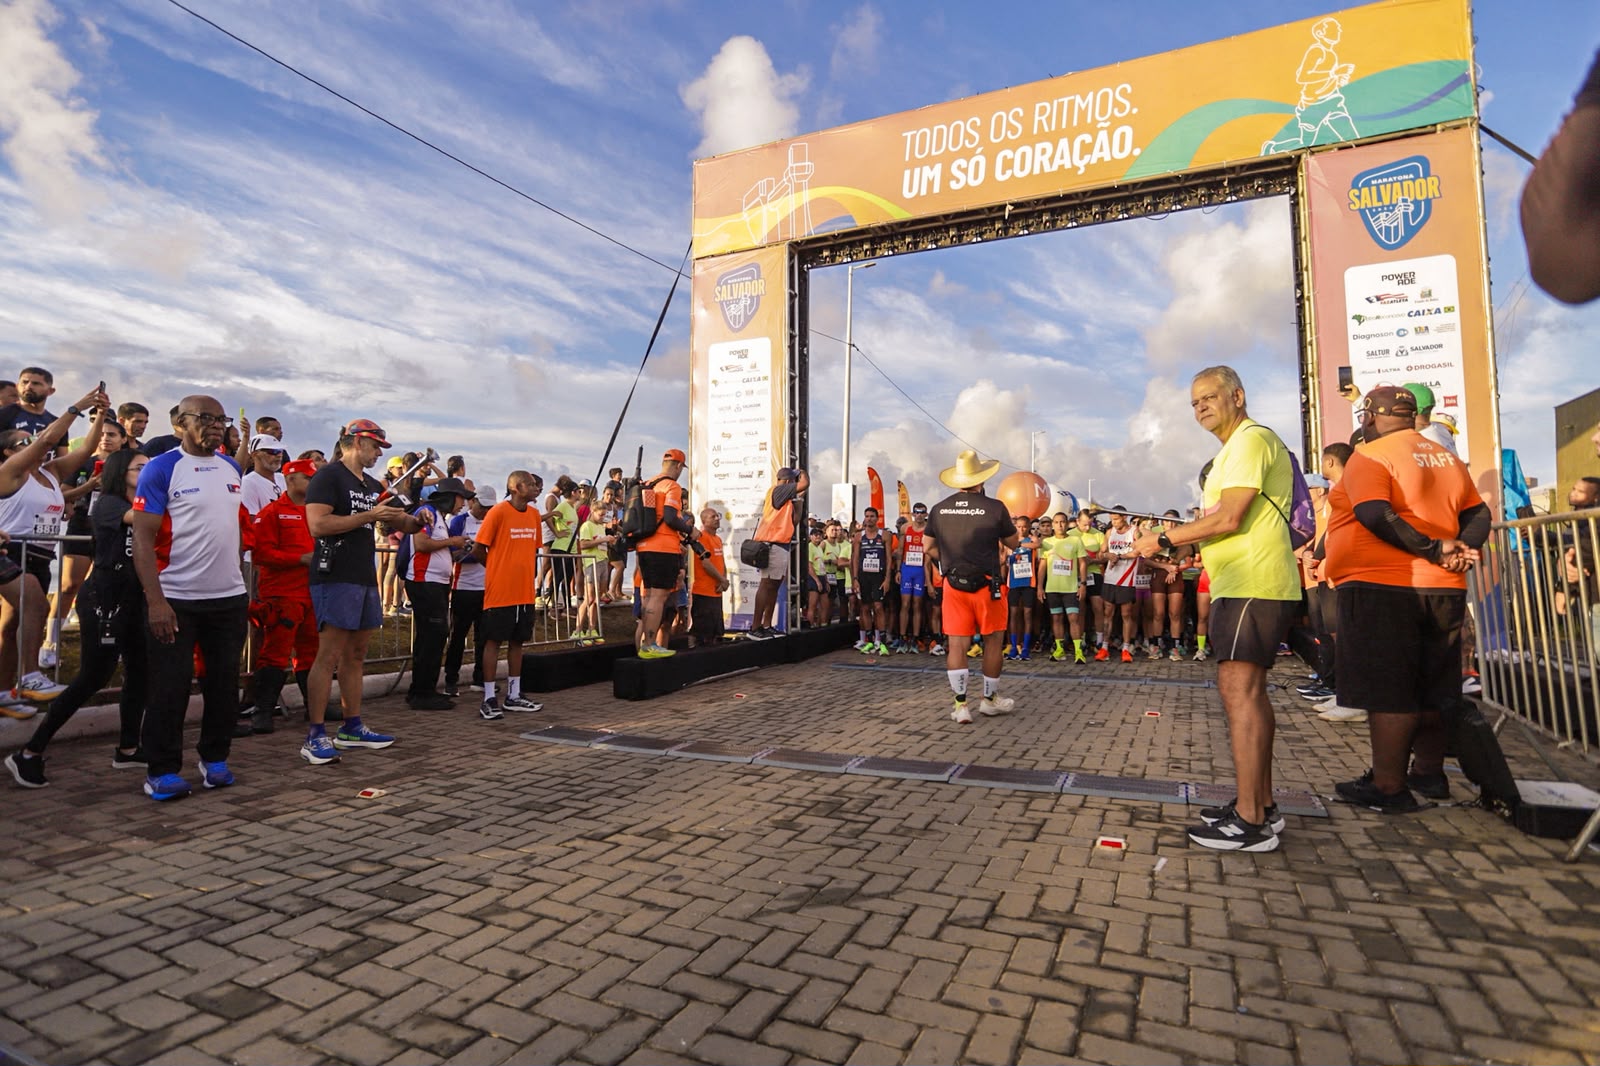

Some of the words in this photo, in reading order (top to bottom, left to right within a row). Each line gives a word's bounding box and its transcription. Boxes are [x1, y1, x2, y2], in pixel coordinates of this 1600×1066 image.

[902, 117, 980, 161] TODOS
[990, 107, 1023, 143] OS
[1033, 83, 1138, 135] RITMOS.
[902, 163, 942, 199] UM
[950, 147, 986, 190] SÓ
[995, 121, 1141, 182] CORAÇÃO.
[1371, 173, 1414, 185] MARATONA
[1349, 176, 1441, 211] SALVADOR
[1381, 271, 1416, 282] POWER
[1397, 278, 1416, 286] ADE
[714, 279, 765, 302] SALVADOR
[1407, 307, 1442, 318] CAIXA
[1366, 349, 1390, 357] SALTUR
[1410, 344, 1443, 352] SALVADOR
[1414, 362, 1454, 371] DROGASIL
[1412, 452, 1455, 468] STAFF
[940, 508, 985, 516] ORGANIZAÇÃO
